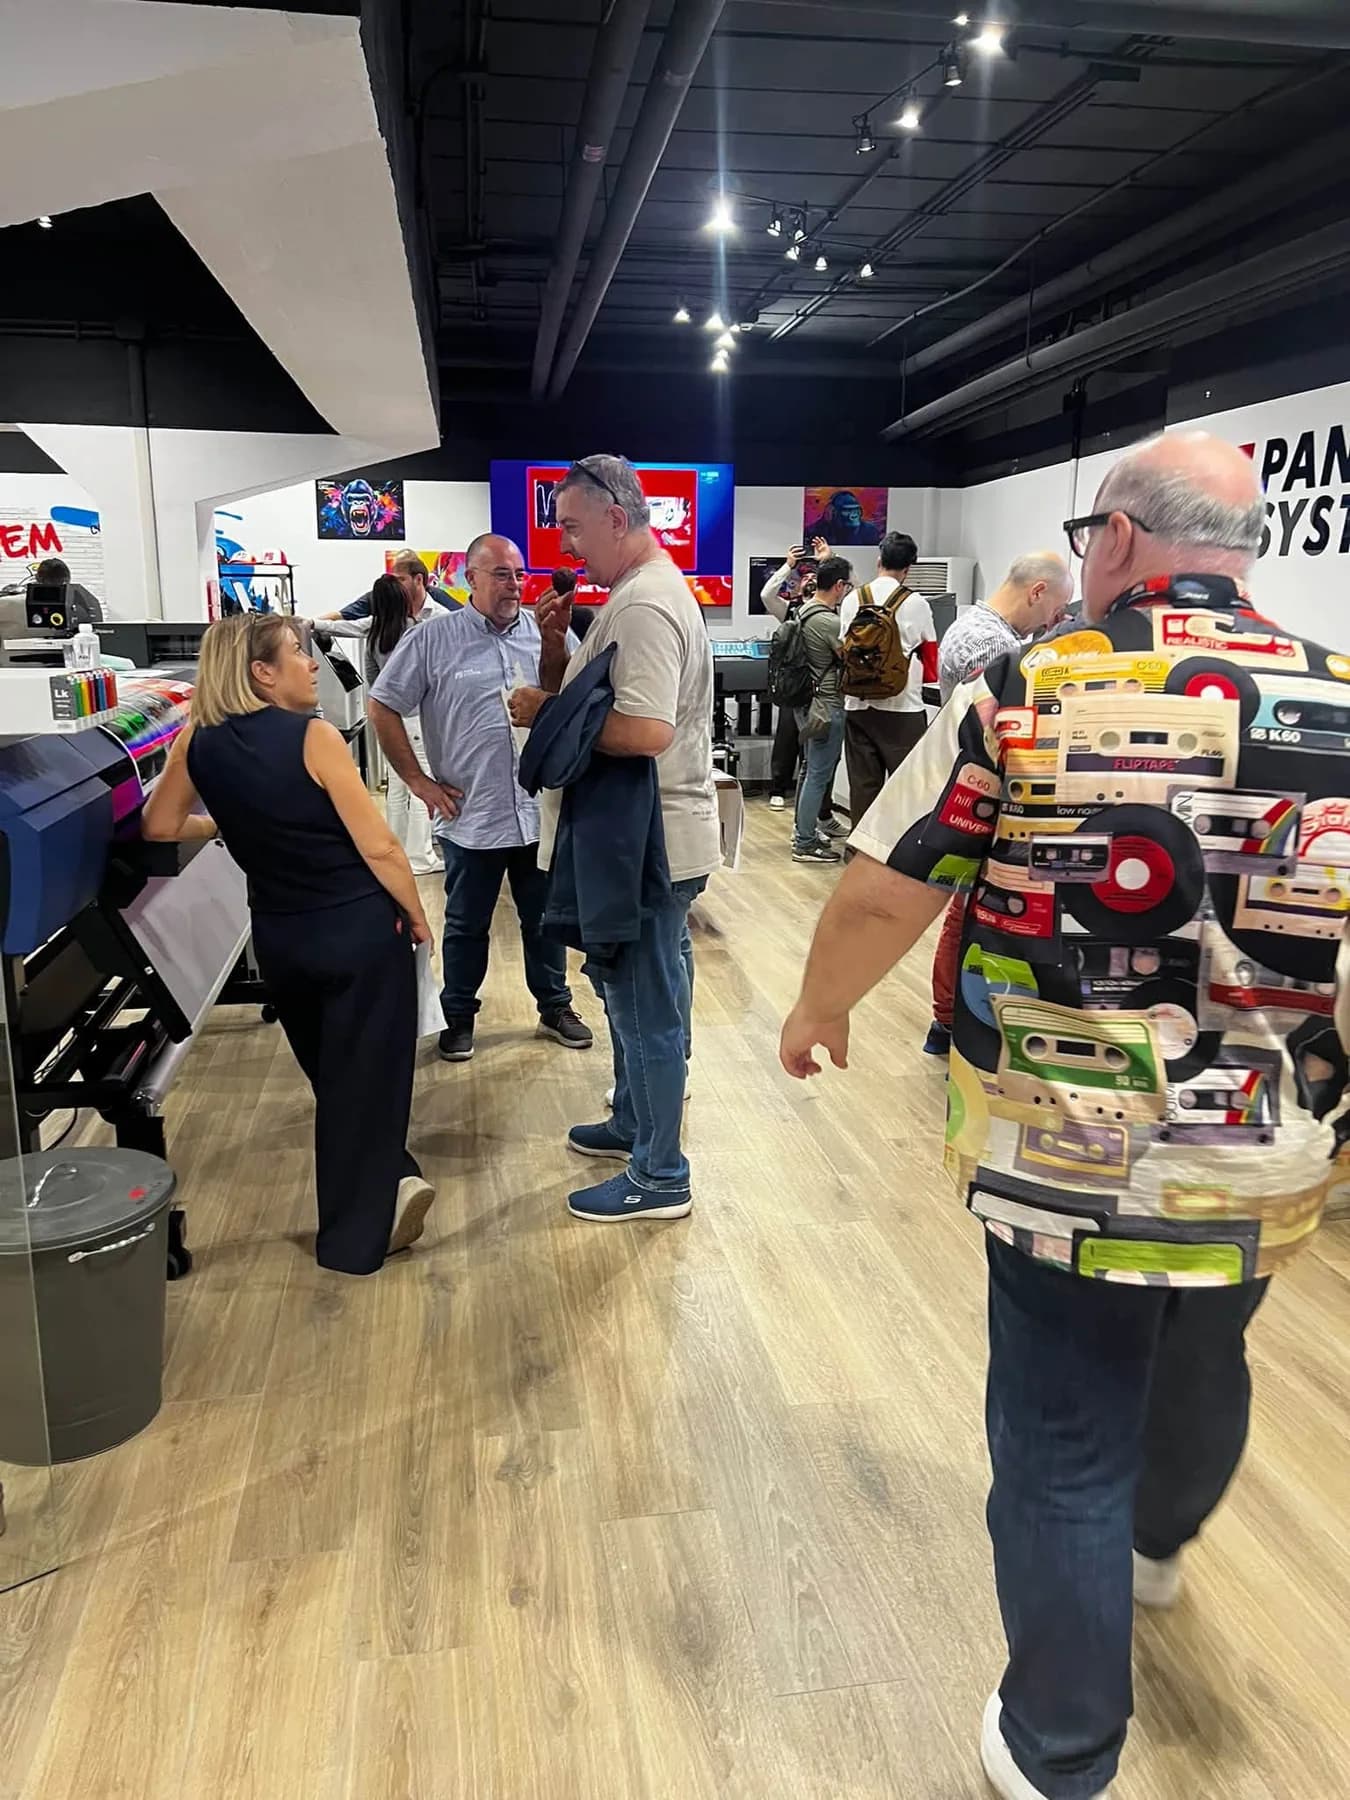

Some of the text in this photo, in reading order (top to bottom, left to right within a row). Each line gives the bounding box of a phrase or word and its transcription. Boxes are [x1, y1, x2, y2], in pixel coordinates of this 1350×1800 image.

[0, 522, 63, 558] EM
[1166, 636, 1228, 650] REALISTIC
[54, 688, 70, 699] Lk
[949, 814, 992, 834] UNIVER
